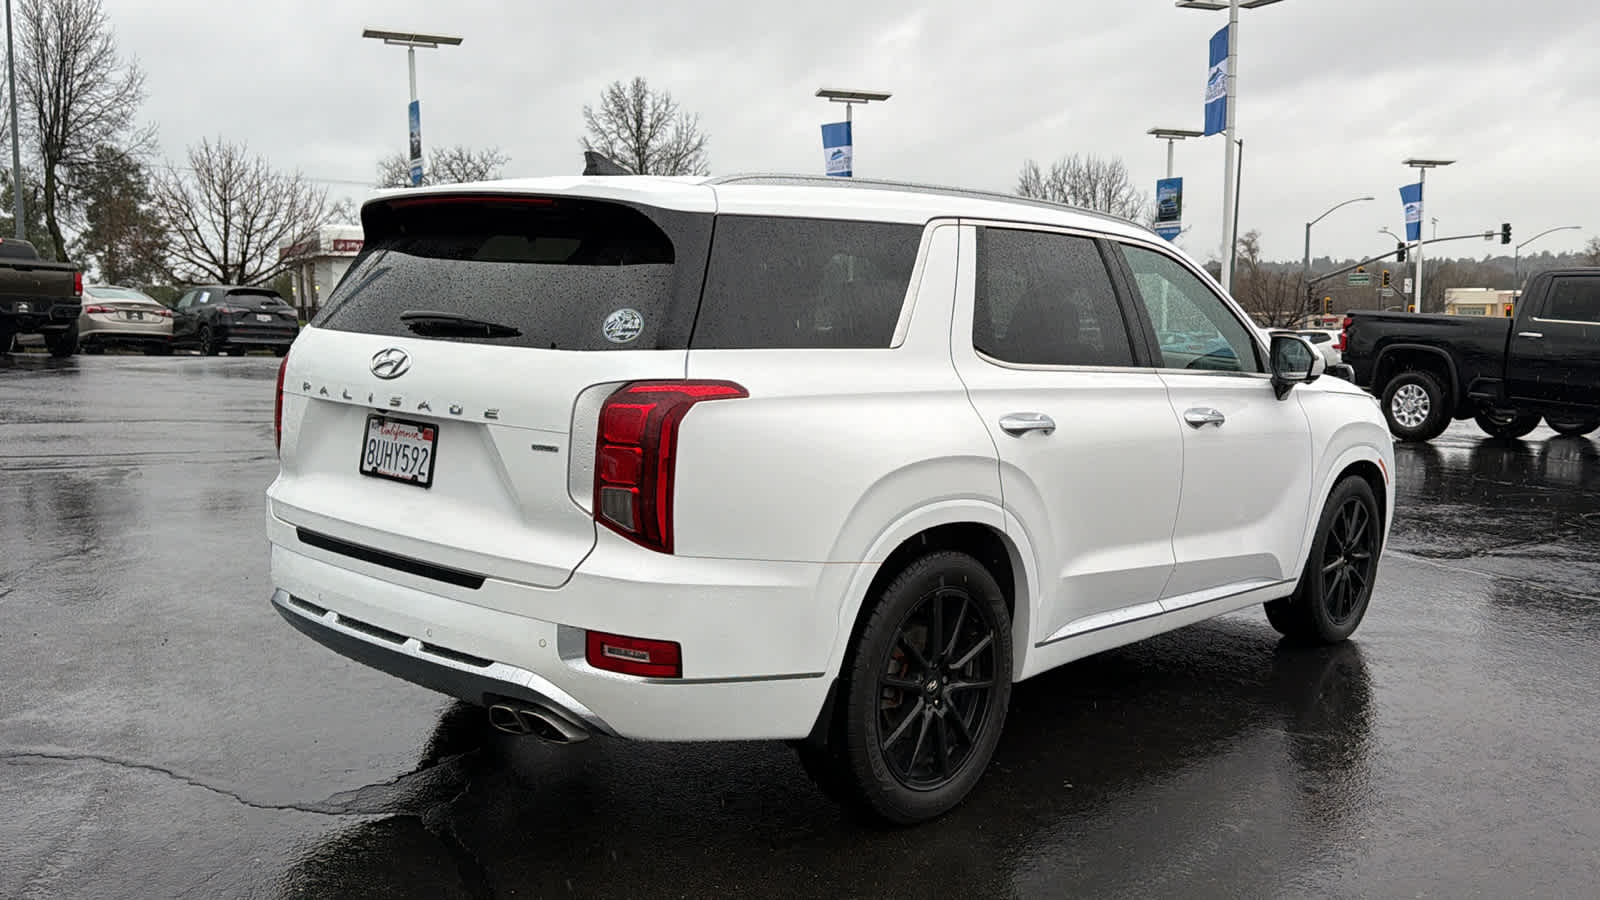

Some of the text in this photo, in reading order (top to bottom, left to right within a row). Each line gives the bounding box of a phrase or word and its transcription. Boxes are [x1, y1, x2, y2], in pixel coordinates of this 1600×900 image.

[303, 382, 500, 420] PALISADE
[380, 422, 422, 441] California
[367, 438, 429, 477] 8UHY592
